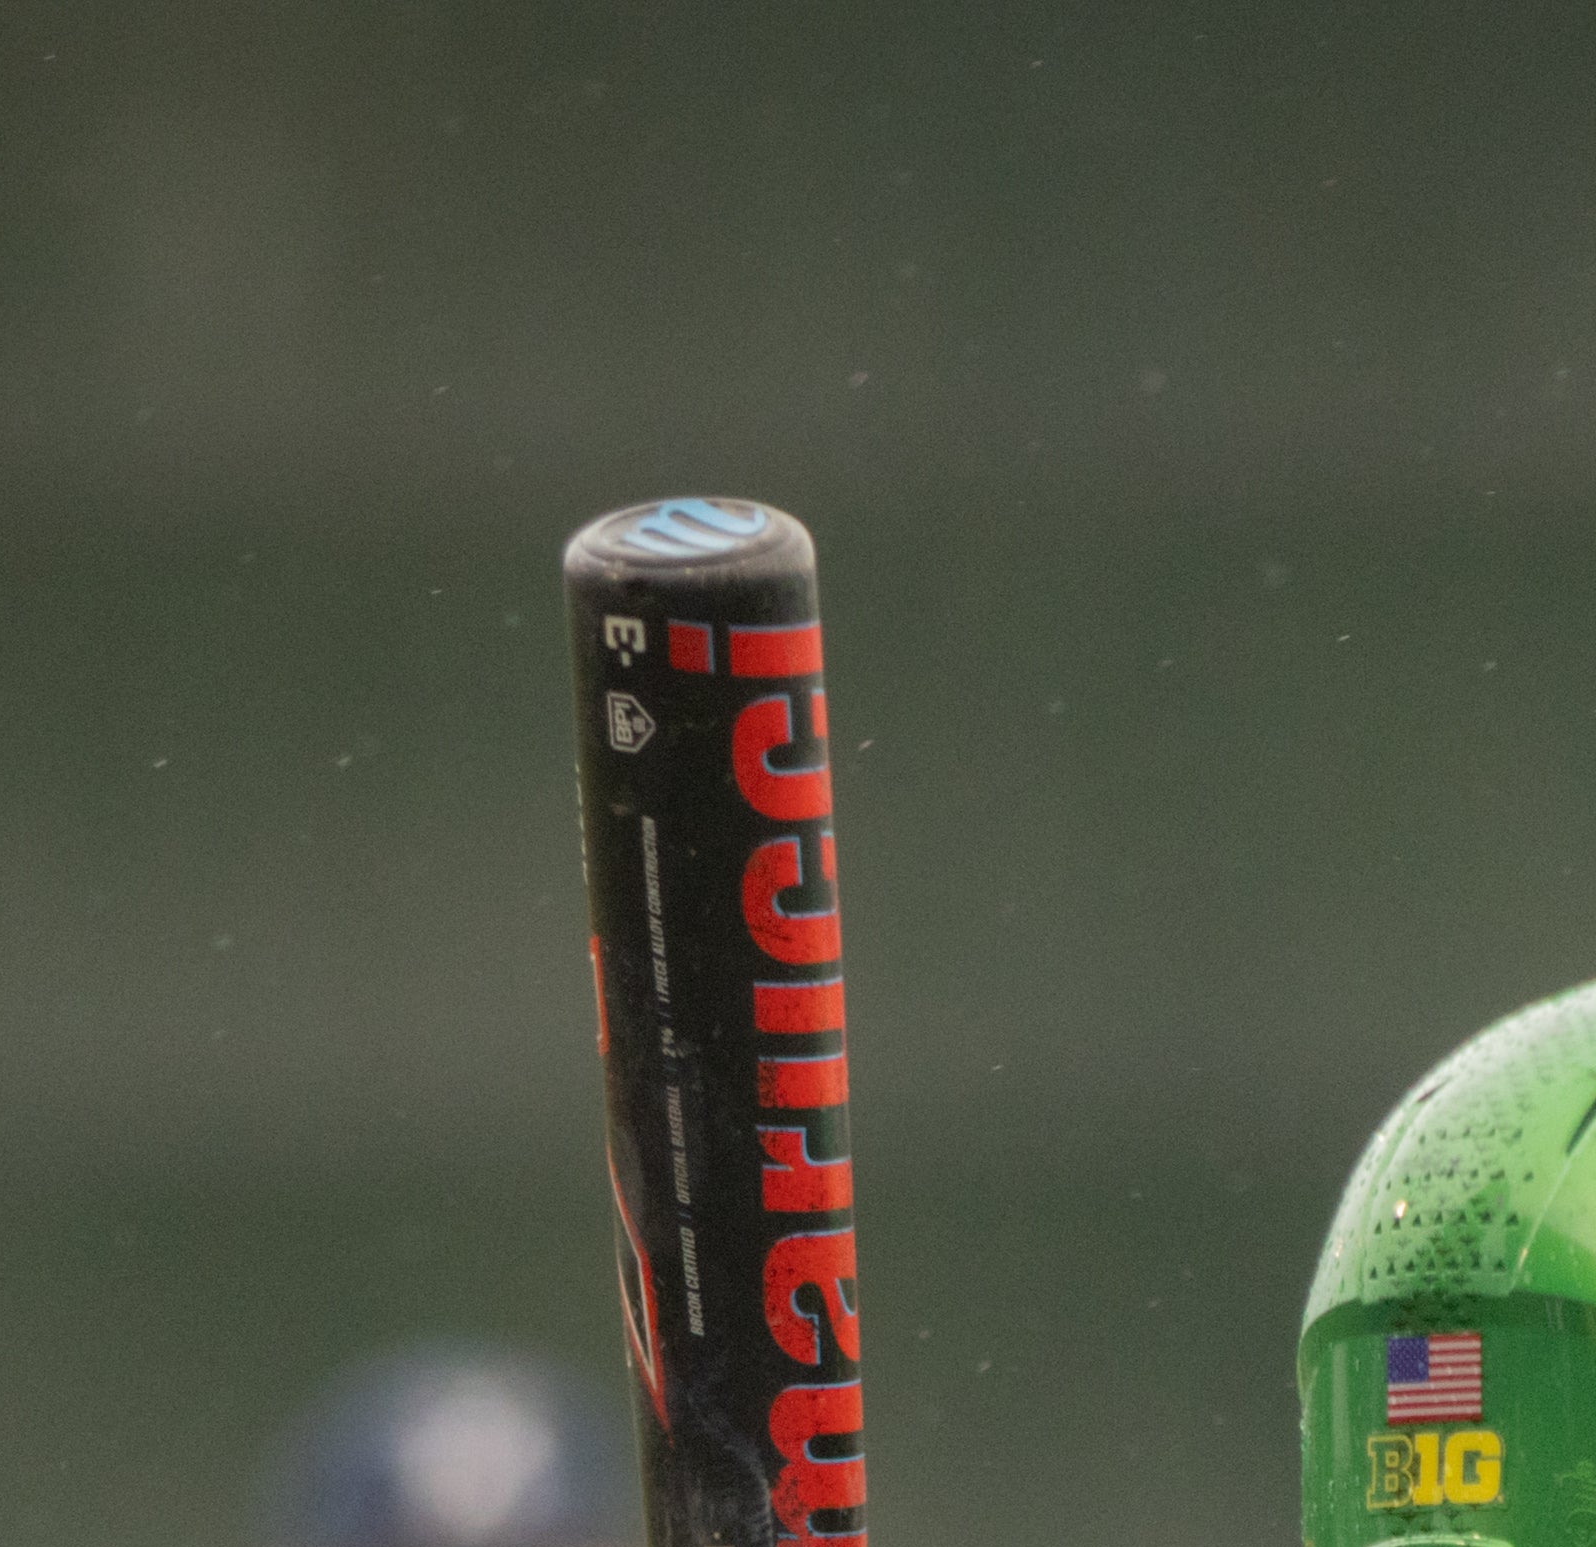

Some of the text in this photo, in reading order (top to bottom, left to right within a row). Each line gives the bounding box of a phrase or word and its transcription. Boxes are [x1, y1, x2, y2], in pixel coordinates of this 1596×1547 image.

[604, 614, 647, 668] -3
[613, 701, 634, 744] BPI
[641, 815, 662, 915] CONSTRUCTION
[648, 914, 665, 957] ALLOY
[652, 956, 669, 996] PIECE
[665, 1084, 685, 1147] BASEBALL
[673, 1149, 691, 1205] OFFICIAL
[679, 1226, 700, 1290] CERTIFIED
[687, 1290, 704, 1336] BBCOR
